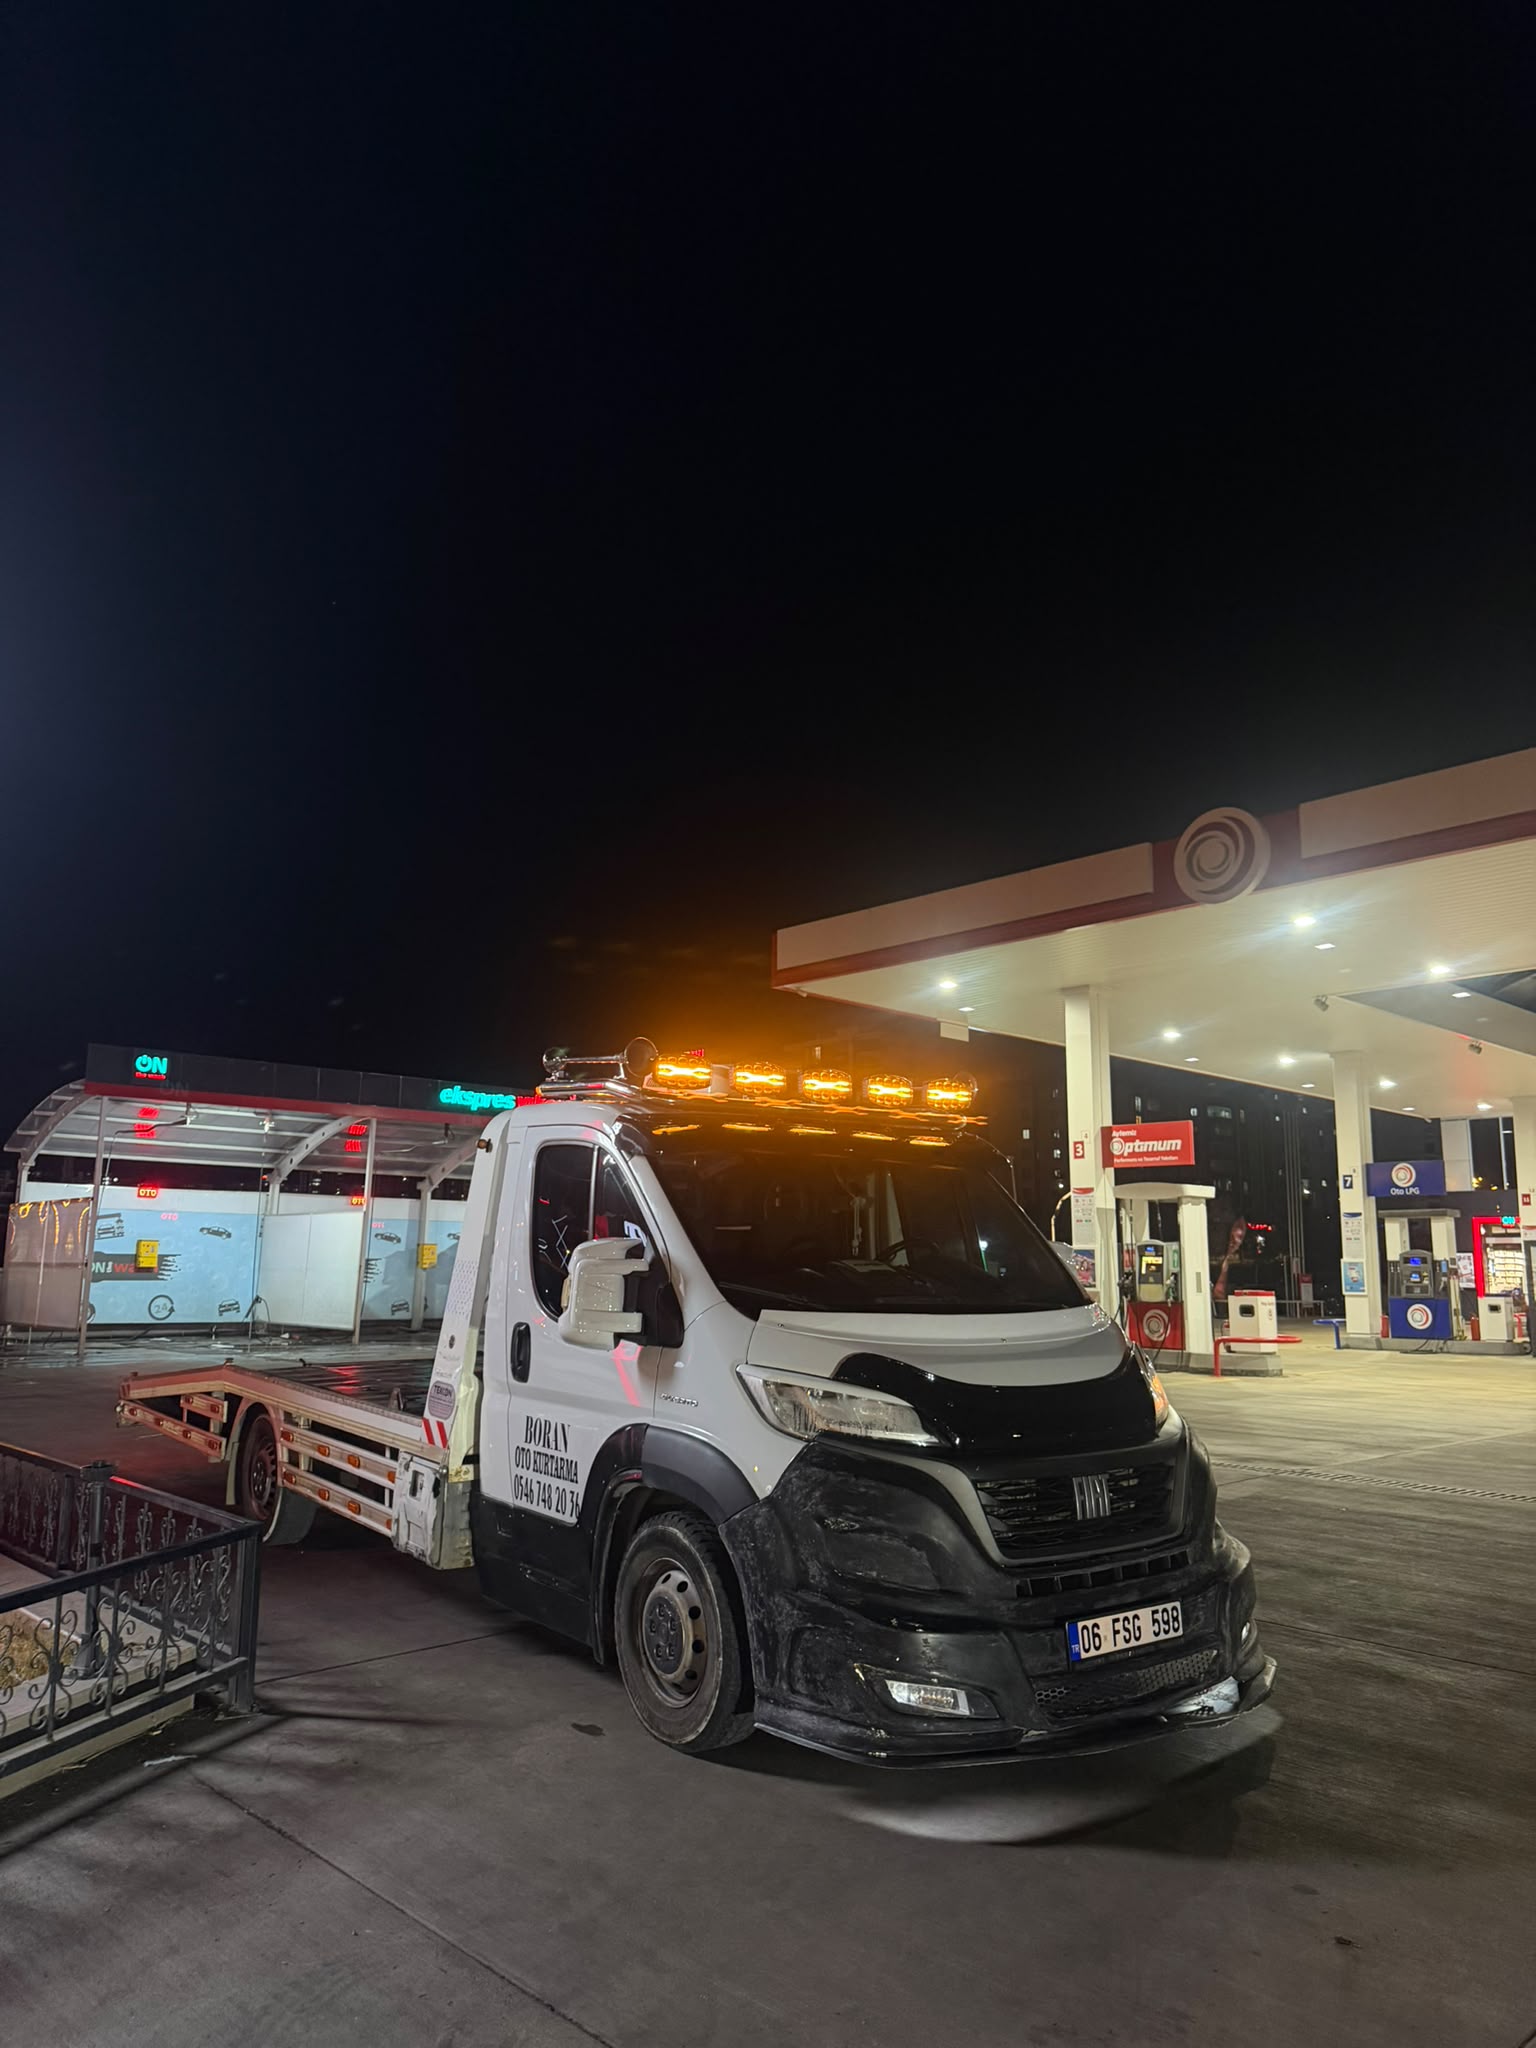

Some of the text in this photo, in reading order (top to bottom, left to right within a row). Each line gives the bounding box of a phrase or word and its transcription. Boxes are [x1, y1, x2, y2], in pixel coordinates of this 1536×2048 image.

[135, 1054, 168, 1074] ON
[439, 1085, 516, 1111] ekspres
[1075, 1143, 1084, 1157] 3
[139, 1189, 157, 1197] OTO
[1343, 1176, 1352, 1188] 7
[1390, 1187, 1405, 1196] Oto
[524, 1415, 571, 1454] BORAN
[514, 1445, 579, 1485] OTO KURTARMA
[513, 1473, 581, 1520] 0546 748 20 36
[1072, 1473, 1112, 1521] FIAT
[1080, 1605, 1181, 1654] 06 FSG 598
[1071, 1643, 1081, 1655] TR
